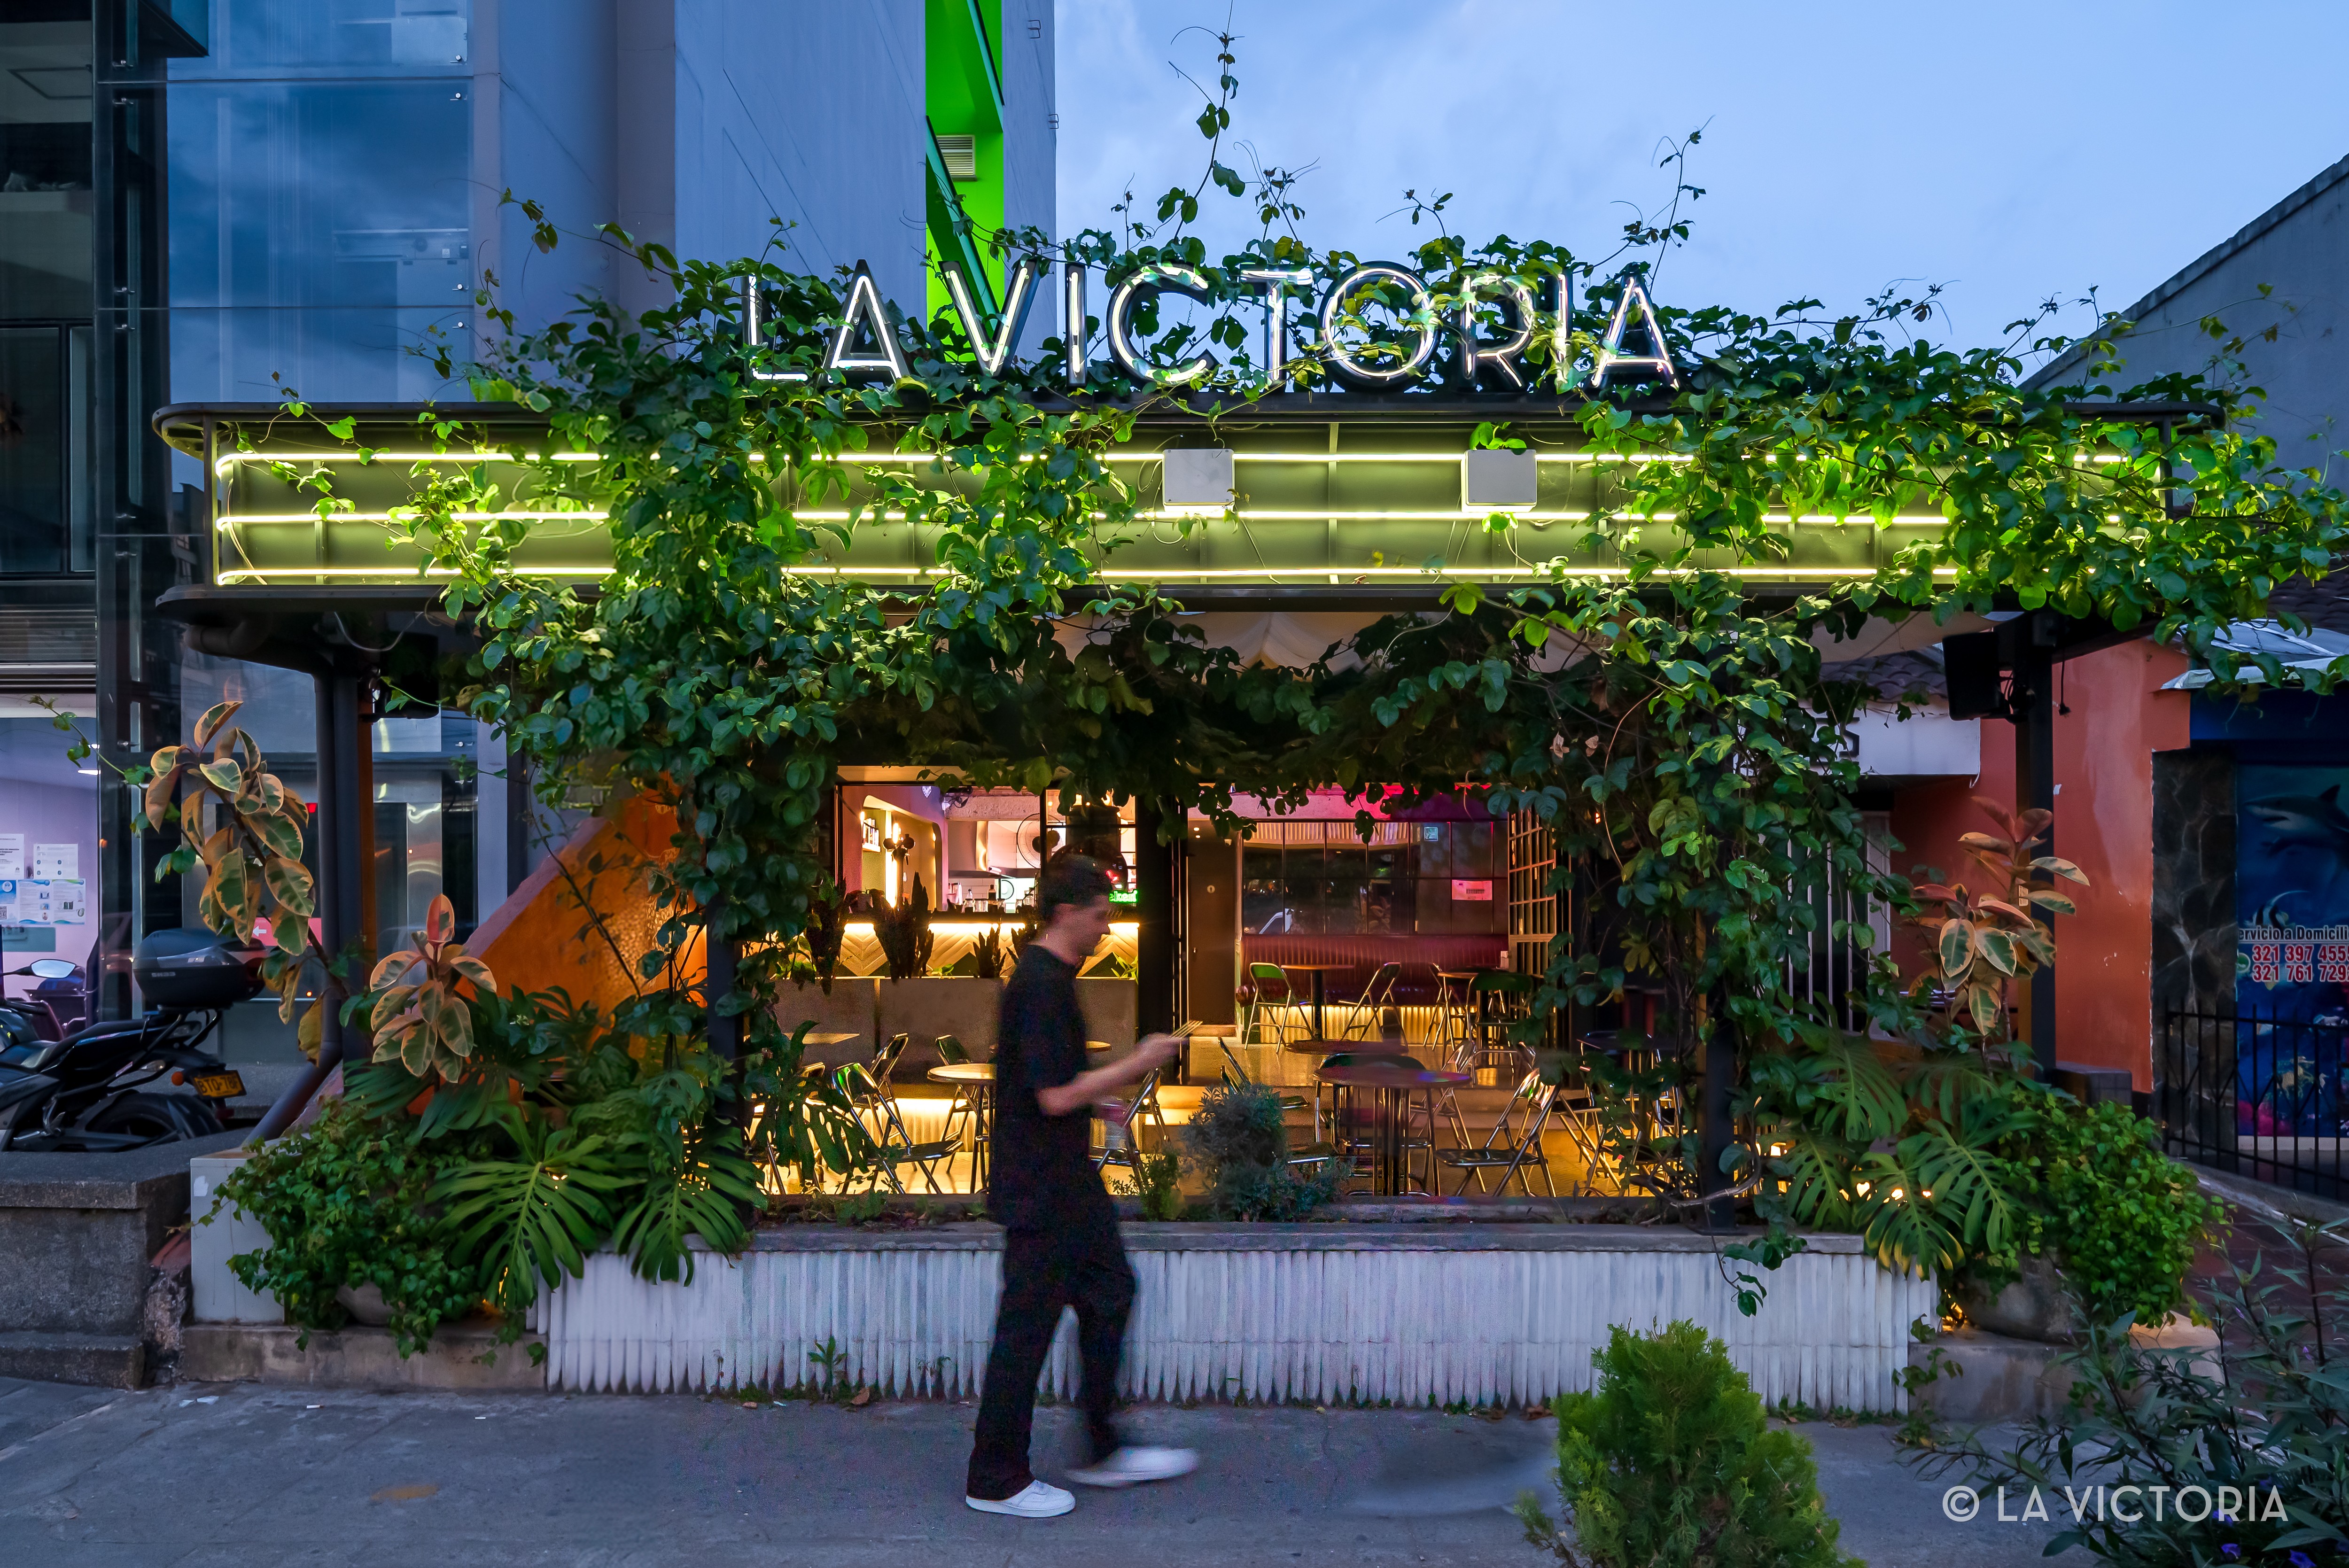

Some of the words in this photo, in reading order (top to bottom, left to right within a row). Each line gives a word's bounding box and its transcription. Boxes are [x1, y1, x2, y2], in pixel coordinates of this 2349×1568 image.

[741, 259, 910, 386] LA
[938, 259, 1681, 390] VICTORIA
[2239, 925, 2280, 940] ervicio
[2284, 928, 2293, 940] a
[2295, 925, 2349, 940] Domicili
[2252, 944, 2279, 963] 321
[2285, 944, 2314, 963] 397
[2318, 944, 2349, 963] 455
[2252, 963, 2279, 982] 321
[2285, 963, 2312, 982] 761
